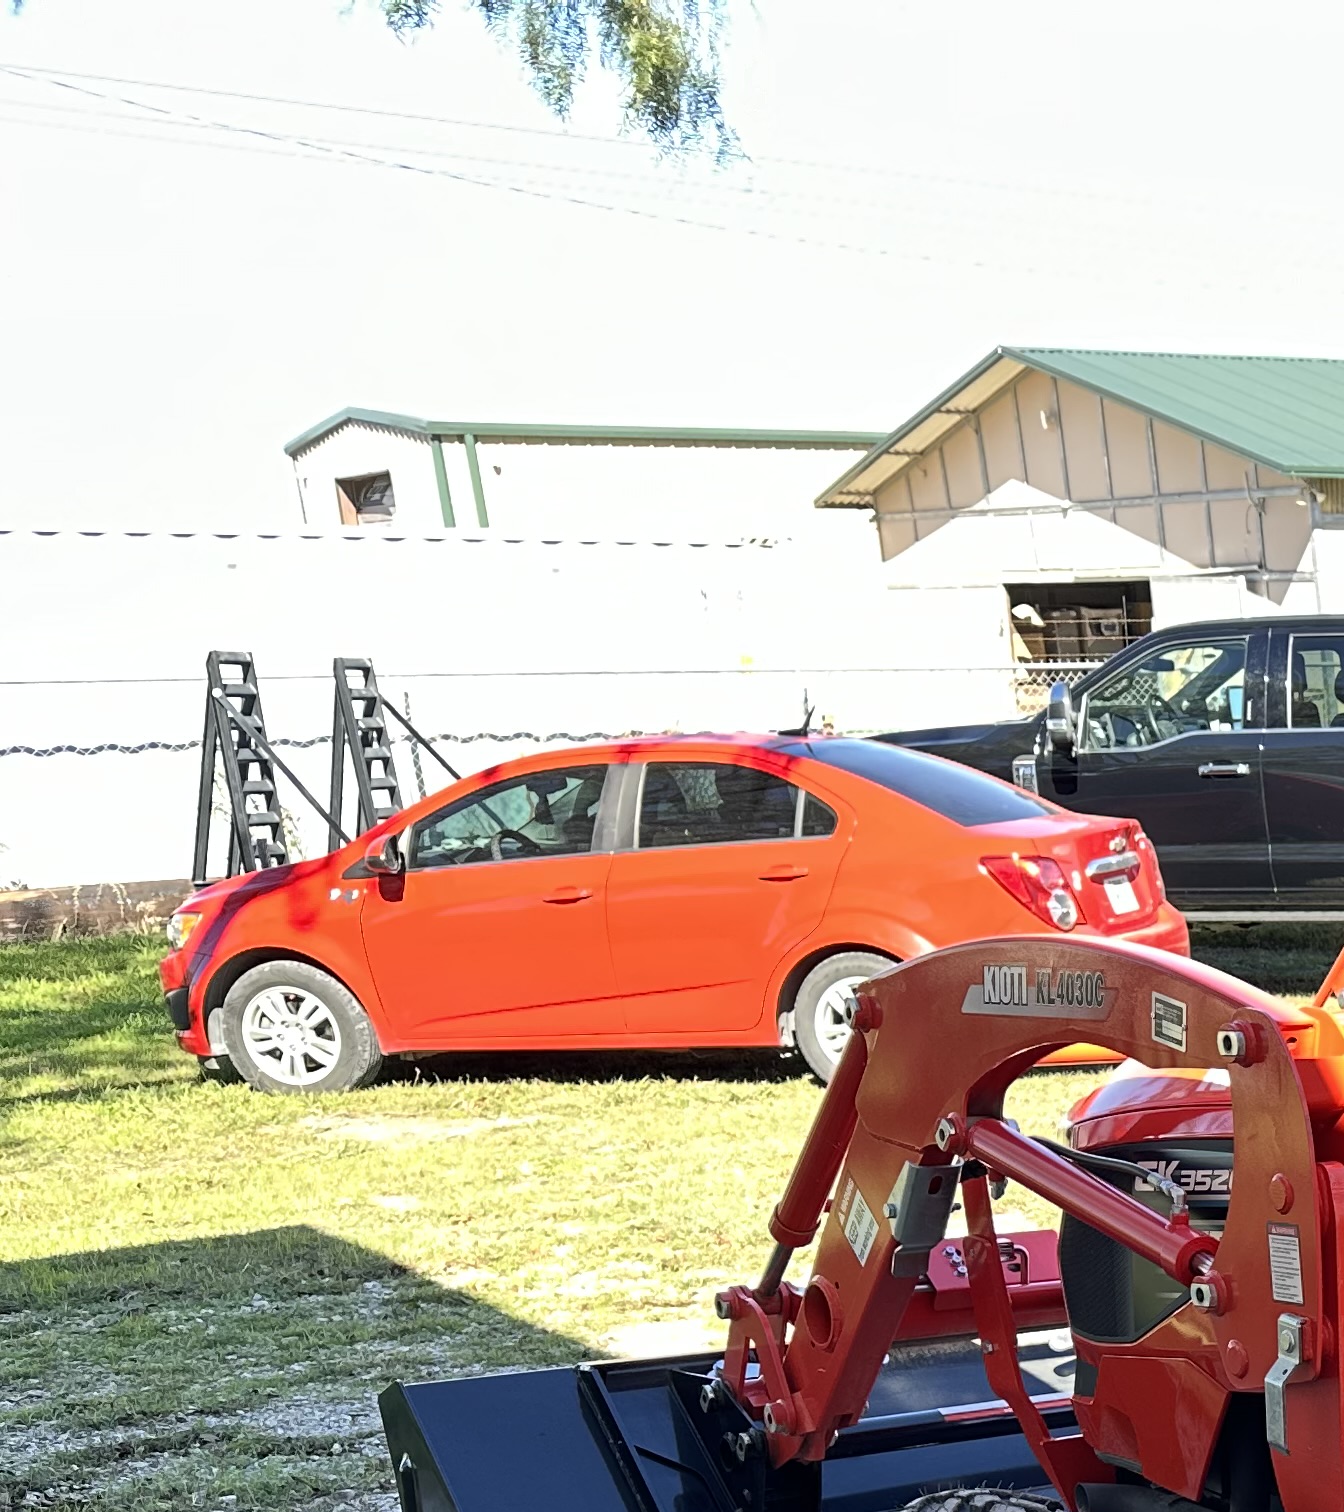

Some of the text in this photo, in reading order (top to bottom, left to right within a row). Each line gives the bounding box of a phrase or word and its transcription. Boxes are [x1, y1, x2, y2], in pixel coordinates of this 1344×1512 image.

[983, 965, 1105, 1008] KIOTI KL4030C
[1134, 1160, 1233, 1192] CK352
